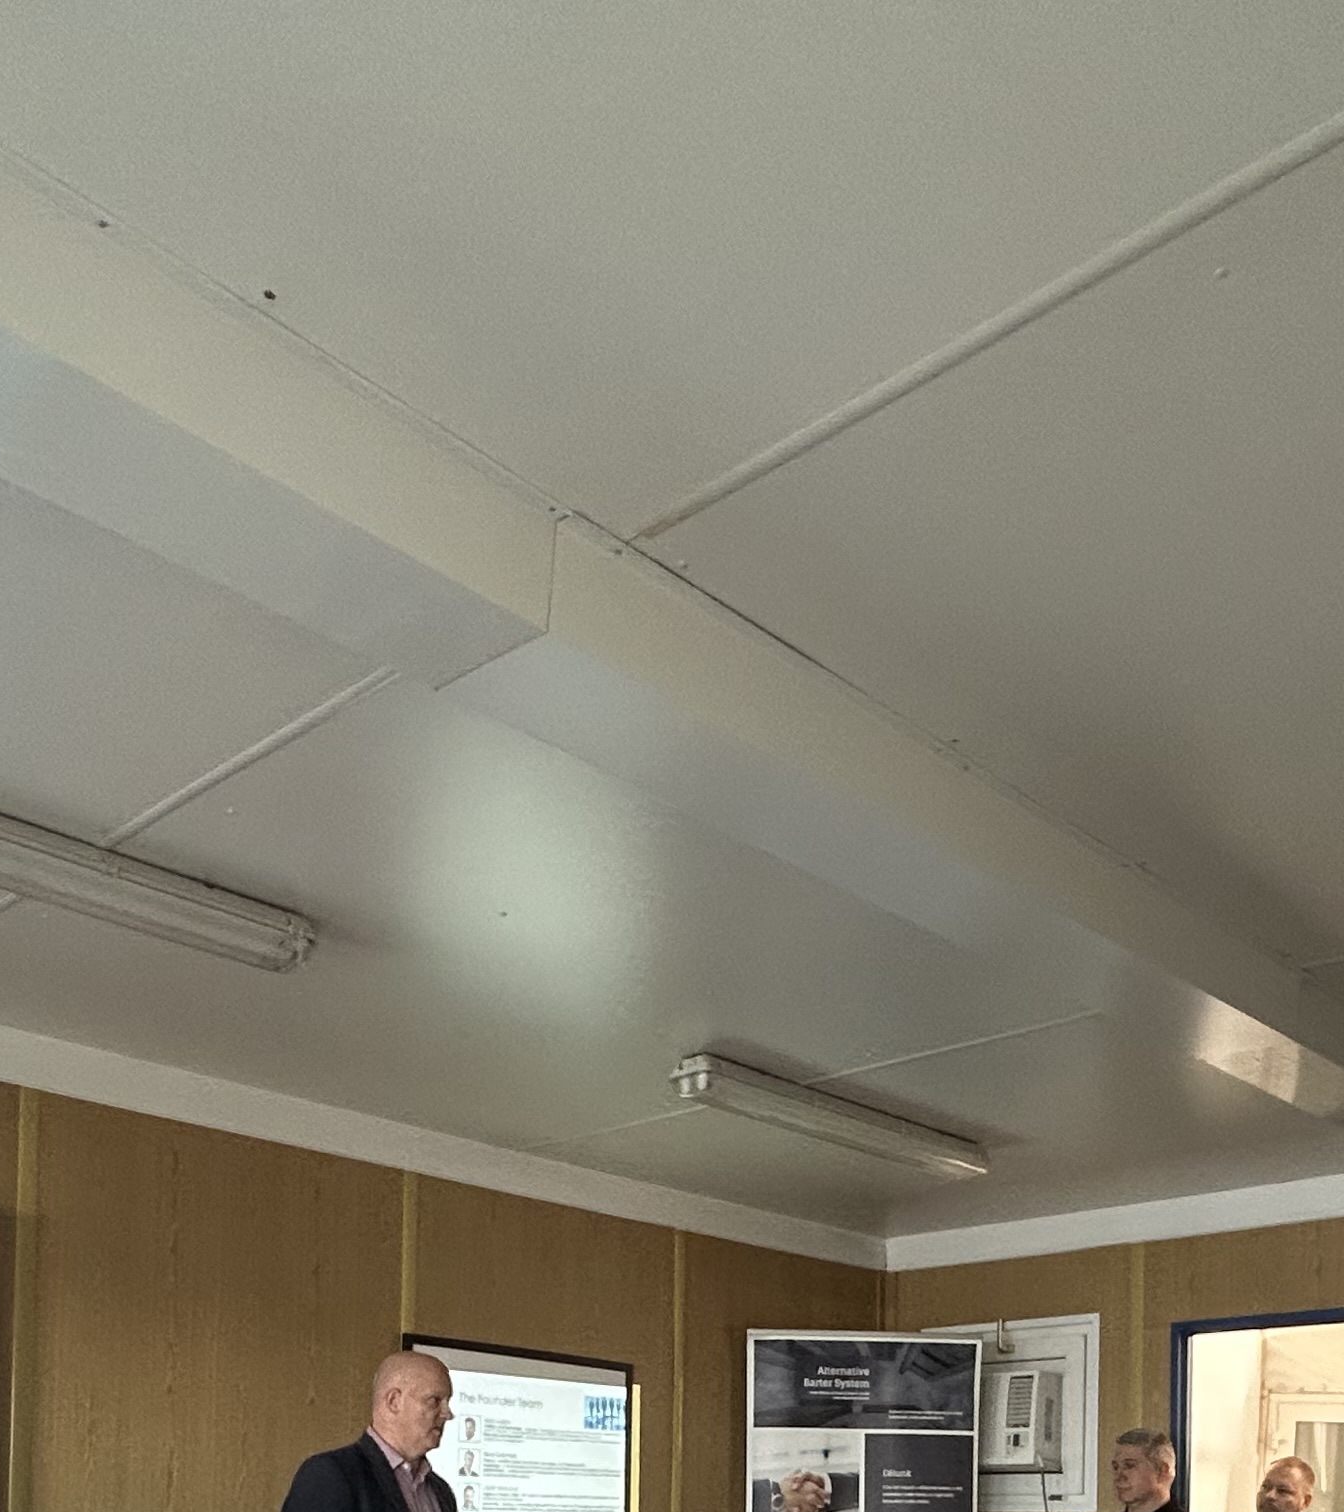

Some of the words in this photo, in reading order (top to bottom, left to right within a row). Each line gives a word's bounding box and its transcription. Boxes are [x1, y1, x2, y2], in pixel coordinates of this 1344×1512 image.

[817, 1366, 870, 1377] Alternative
[804, 1378, 832, 1388] Barter
[834, 1379, 870, 1389] System
